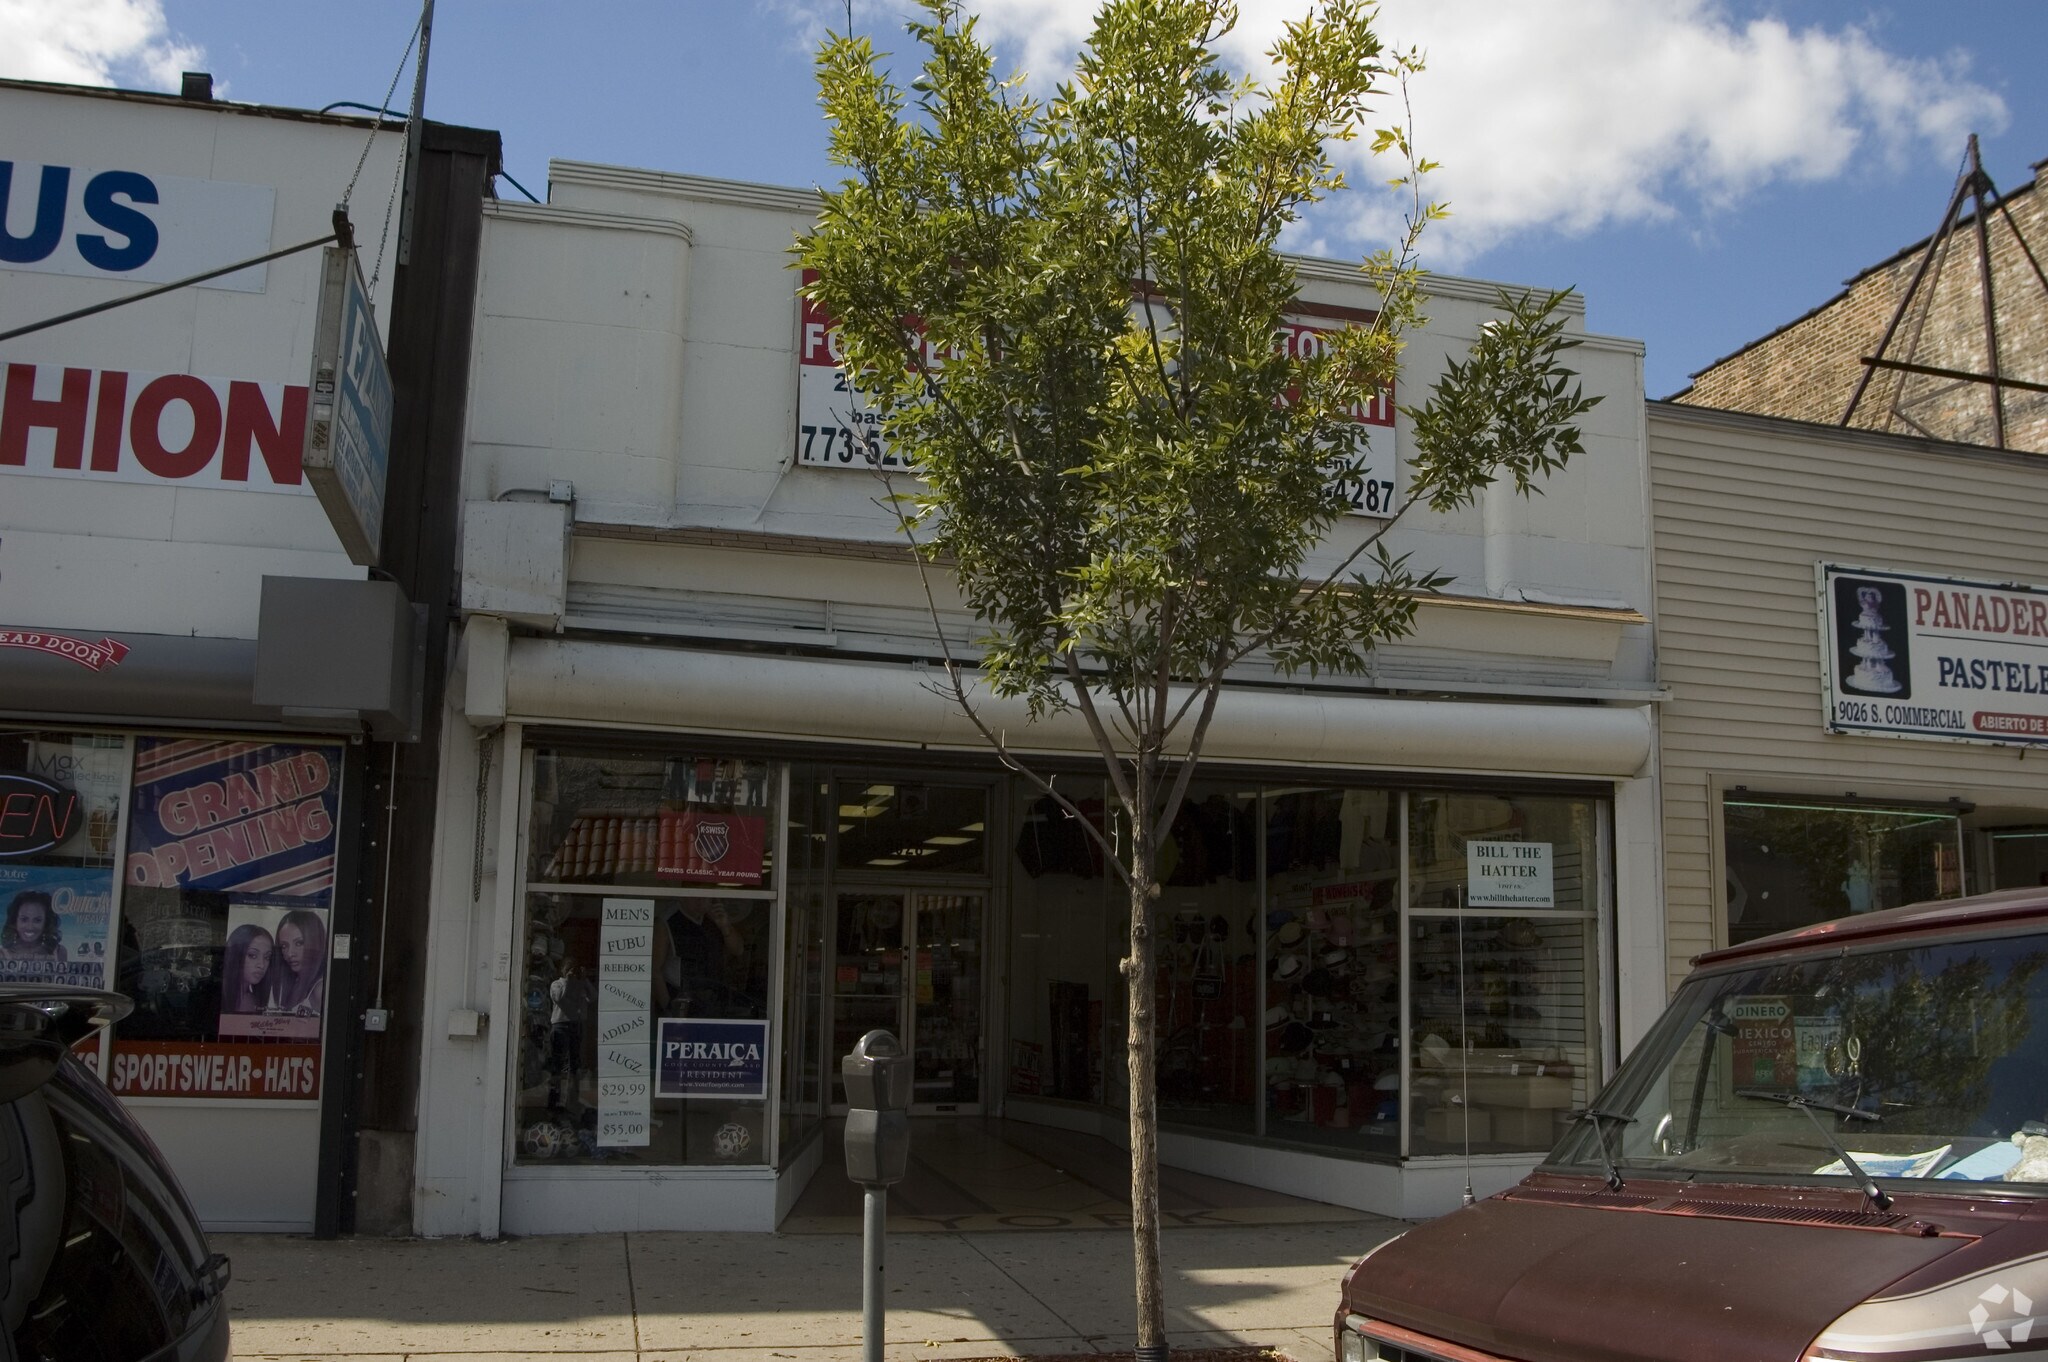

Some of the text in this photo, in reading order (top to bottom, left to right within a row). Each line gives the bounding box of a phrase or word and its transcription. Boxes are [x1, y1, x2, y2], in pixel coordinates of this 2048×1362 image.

[0, 363, 309, 486] HION
[1914, 588, 2048, 638] PANADER
[45, 637, 101, 665] DOOR
[1839, 701, 1966, 730] 9026 S. COMMERCIAL
[1980, 715, 2044, 732] ABIERTO DE
[159, 752, 331, 836] GRAND
[700, 825, 726, 835] K-SWISS
[127, 796, 333, 888] OPENING
[1476, 845, 1542, 859] BILL THE
[657, 866, 684, 874] K-SWISS
[1481, 865, 1538, 877] HATTER
[1469, 894, 1551, 903] www.billthehatter.com
[605, 907, 650, 920] MEN'S
[607, 936, 646, 952] FUBU
[604, 963, 646, 973] REEBOK
[604, 983, 645, 1009] CONVERSE
[1736, 1006, 1786, 1017] DINERO
[601, 1016, 645, 1042] ADIDAS
[665, 1041, 761, 1061] PERAICA
[608, 1050, 643, 1073] LUGZ
[679, 1070, 744, 1079] PRESIDENT
[602, 1083, 646, 1097] $29.99
[603, 1123, 643, 1137] $55.00
